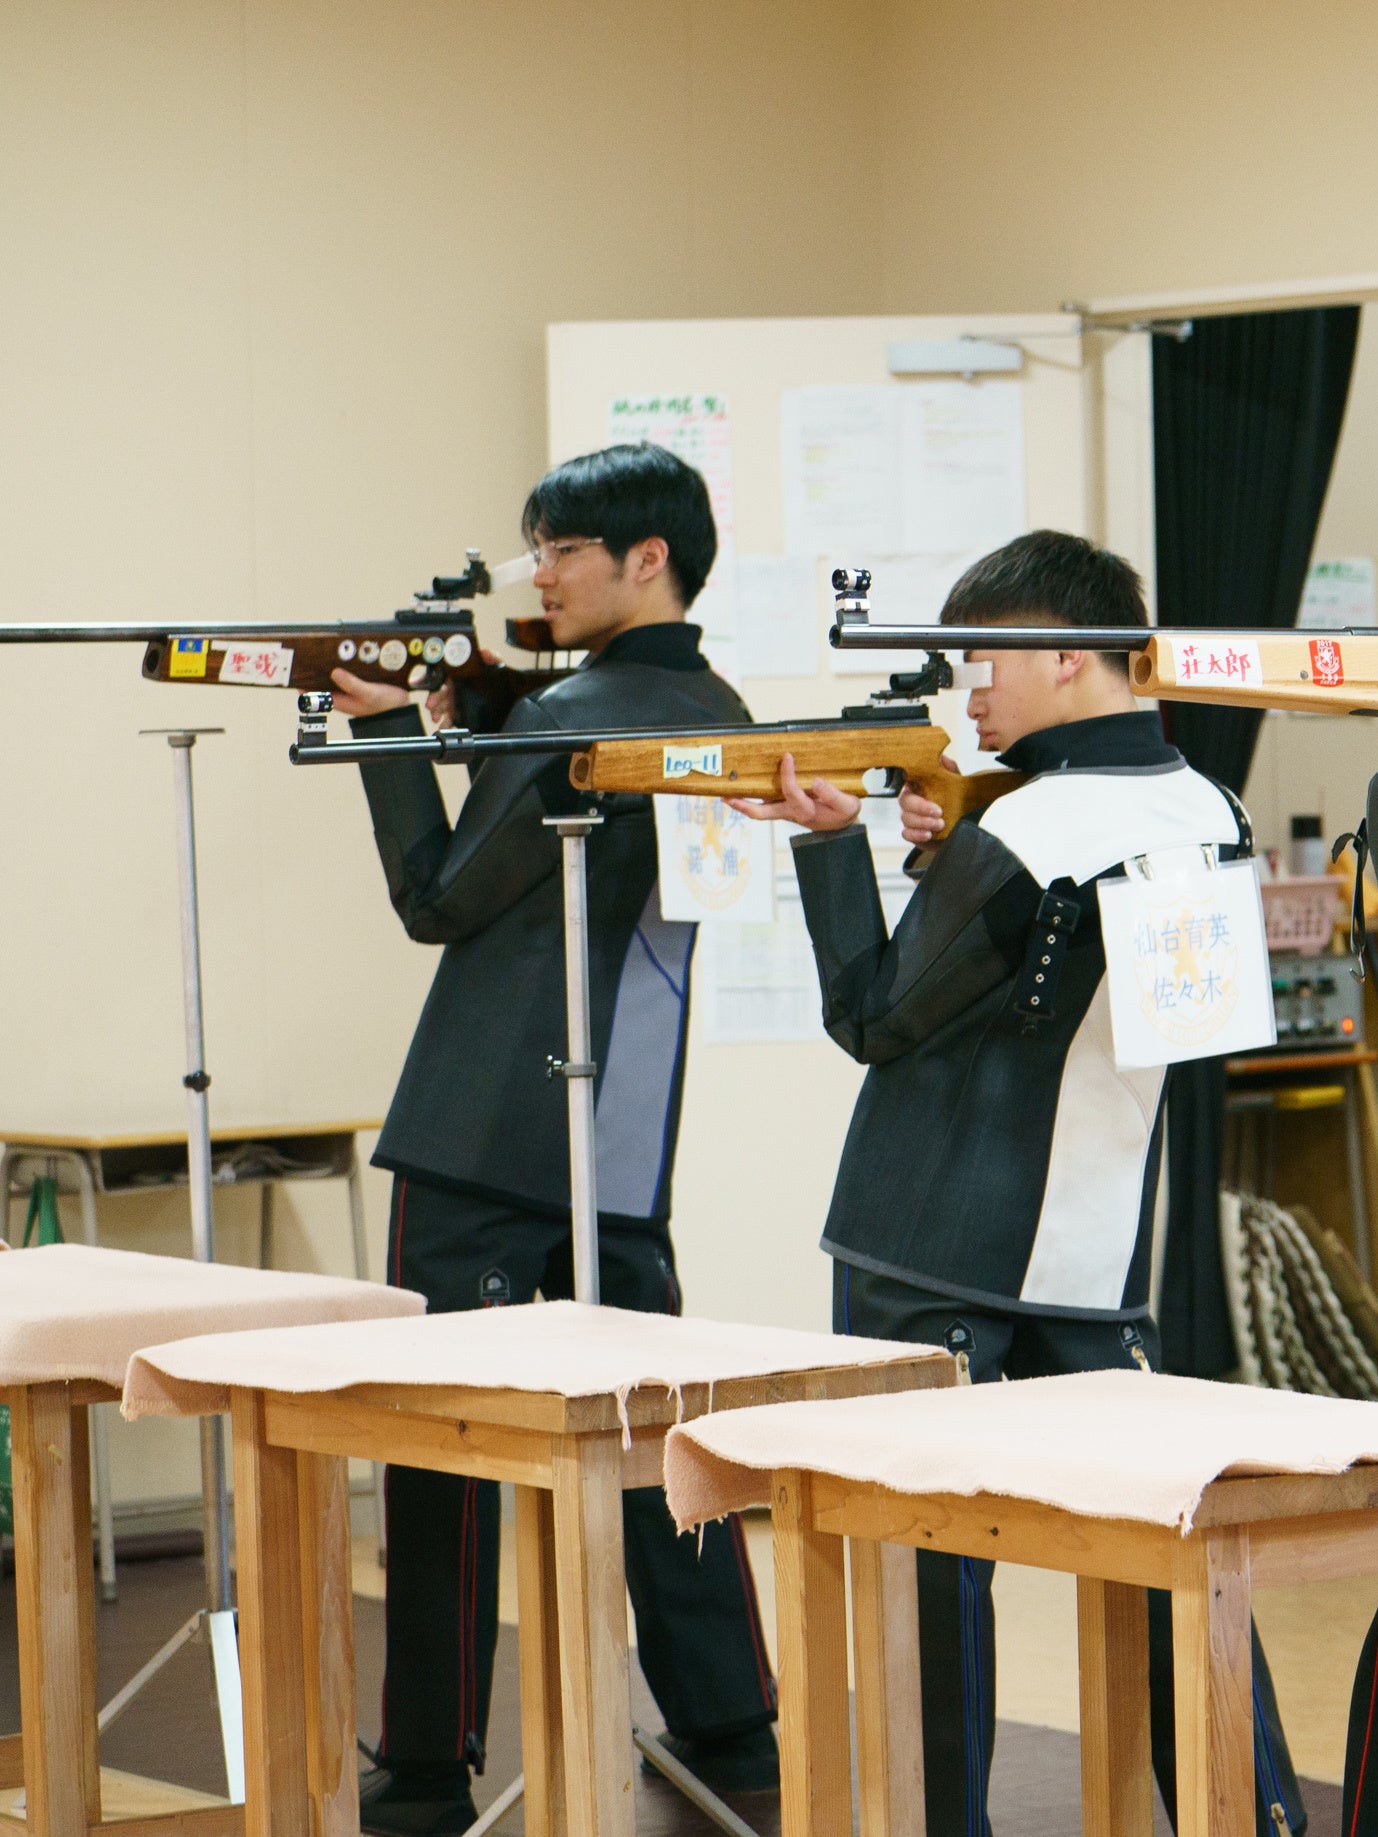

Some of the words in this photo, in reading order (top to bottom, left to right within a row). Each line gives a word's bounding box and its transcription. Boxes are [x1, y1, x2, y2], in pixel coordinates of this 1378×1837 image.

[1133, 912, 1231, 957] 仙台育英
[1152, 969, 1223, 1011] 佐々木
